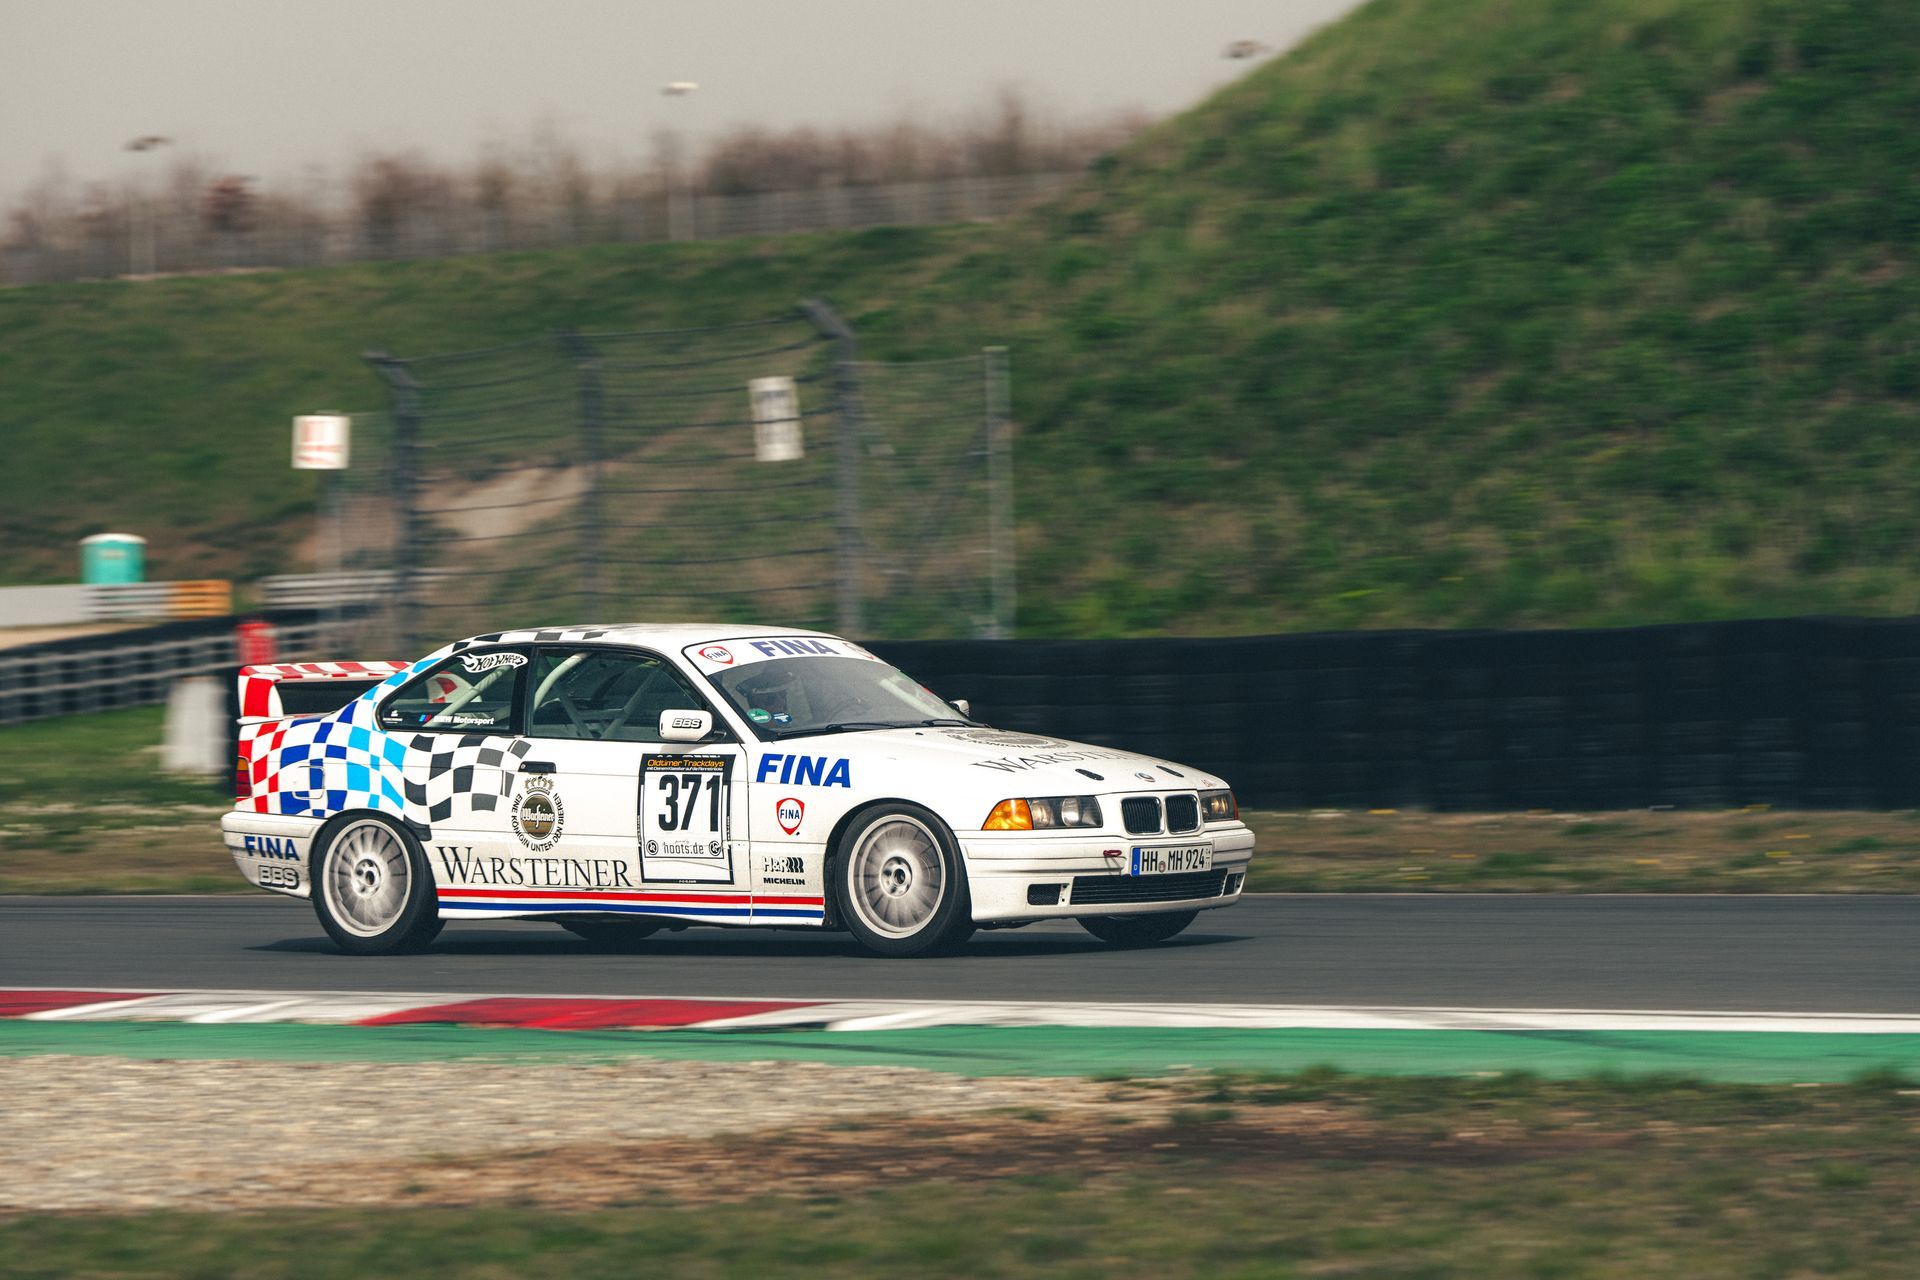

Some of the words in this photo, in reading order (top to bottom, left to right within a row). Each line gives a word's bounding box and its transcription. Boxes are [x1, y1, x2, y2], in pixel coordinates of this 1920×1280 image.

[706, 649, 728, 660] FINA
[749, 640, 841, 657] FINA
[453, 716, 495, 726] Motorsport
[672, 717, 703, 729] BBS
[647, 759, 682, 767] Oldtimer
[684, 759, 725, 767] Trackdays
[756, 752, 851, 788] FINA
[658, 773, 720, 832] 371
[780, 808, 800, 819] FINA
[511, 793, 523, 813] EINE
[530, 841, 554, 852] UNTER
[552, 793, 564, 825] BIEREN
[244, 835, 301, 861] FINA
[663, 841, 704, 854] hoots.de
[435, 846, 634, 887] WARSTEINER
[1141, 850, 1158, 871] HH
[1168, 850, 1183, 871] MH
[1185, 848, 1204, 869] 924
[258, 865, 299, 889] BBS
[763, 877, 805, 885] MICHELIN
